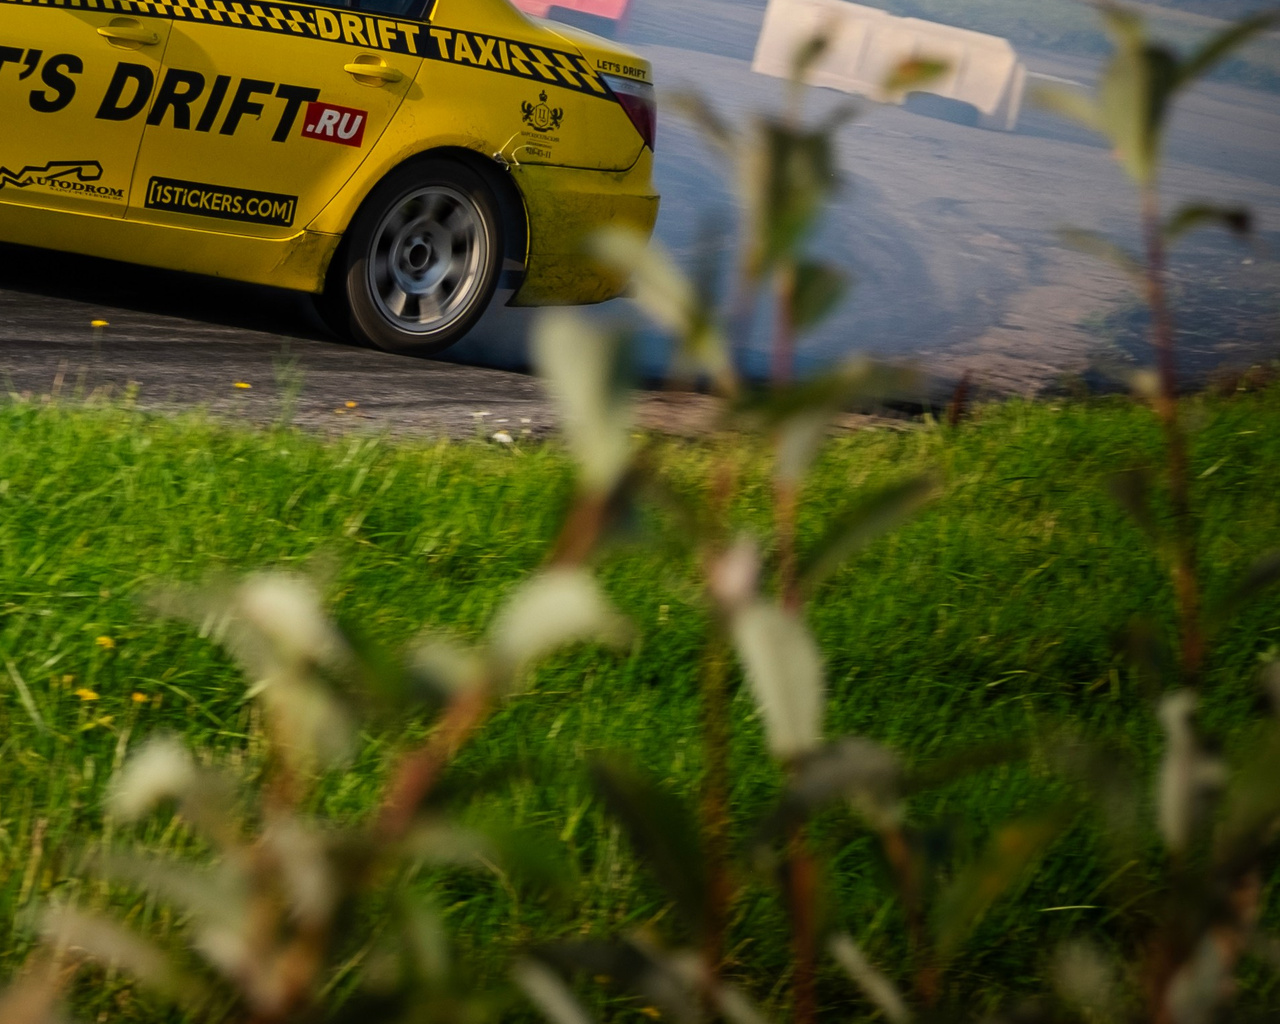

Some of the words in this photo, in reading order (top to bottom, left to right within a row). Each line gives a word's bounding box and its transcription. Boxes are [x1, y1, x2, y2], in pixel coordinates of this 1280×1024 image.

[314, 8, 420, 55] DRIFT
[429, 28, 511, 71] TAXI
[596, 59, 620, 73] LET'S
[622, 65, 646, 80] DRIFT
[22, 175, 125, 198] AUTODROM
